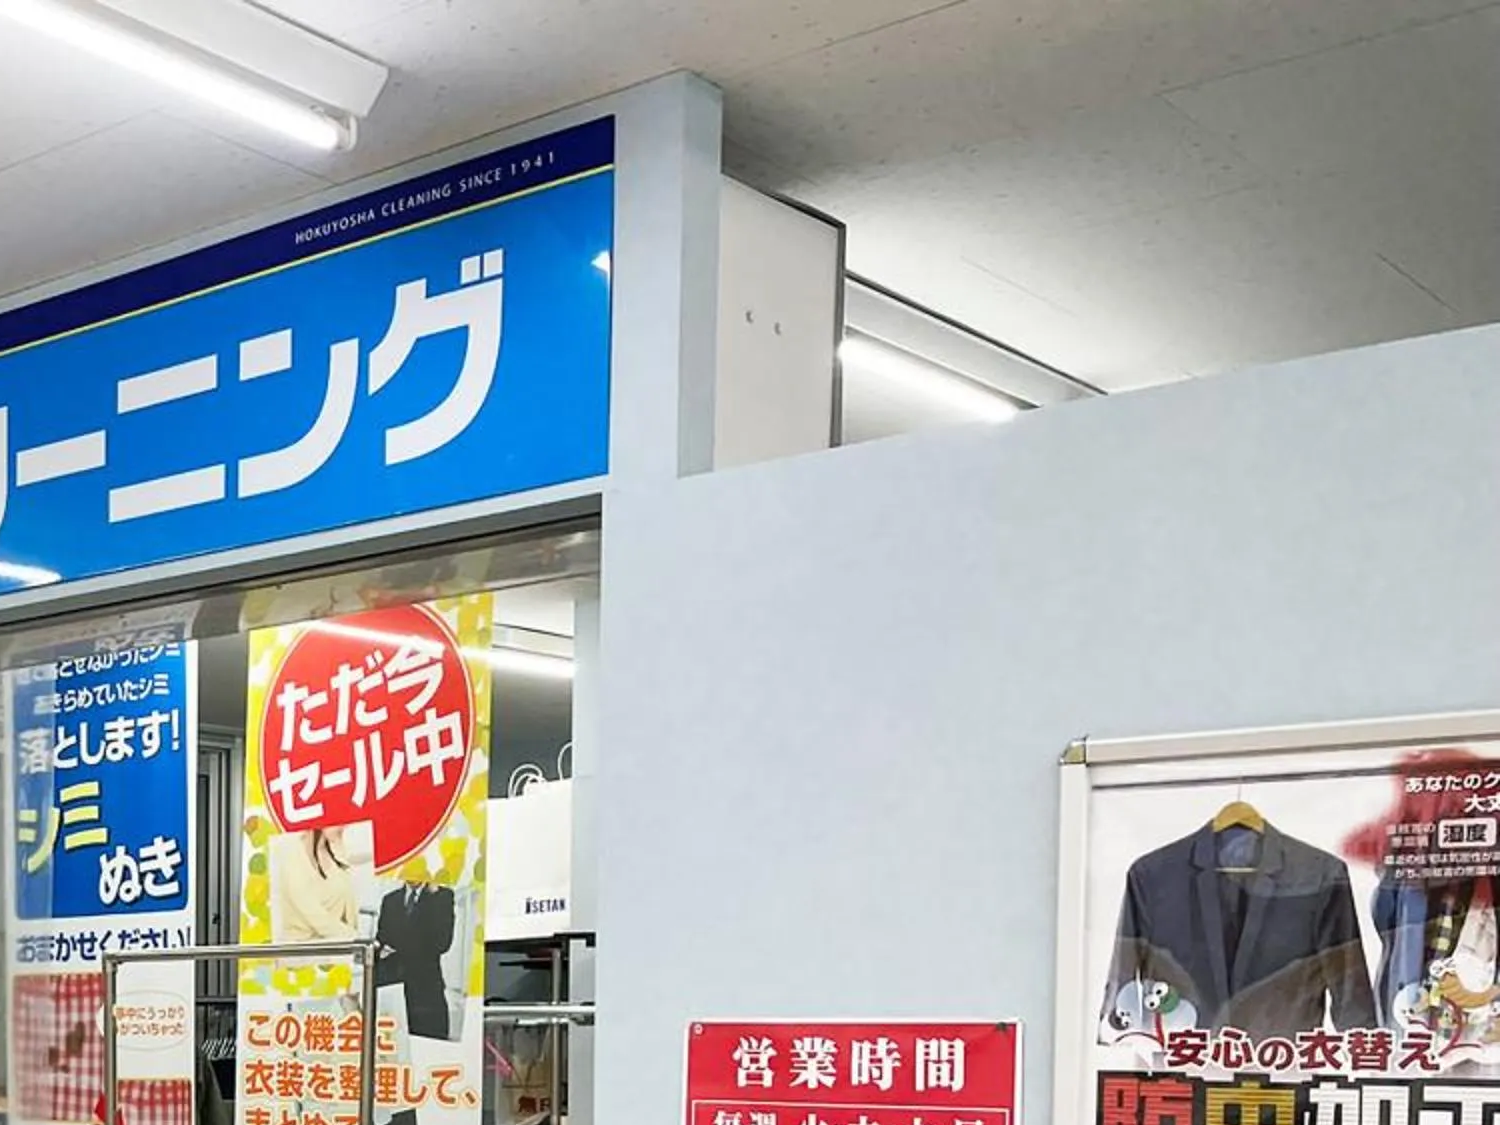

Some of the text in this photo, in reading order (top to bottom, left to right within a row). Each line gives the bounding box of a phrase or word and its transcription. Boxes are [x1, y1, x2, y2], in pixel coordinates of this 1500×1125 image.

[294, 151, 556, 244] HOKUYOSHA CLEANING SINCE 1941
[277, 636, 446, 751] ただ今
[270, 708, 465, 823] セール中
[17, 781, 109, 874] シミ
[98, 836, 183, 906] ぬき
[245, 1014, 396, 1053] この機会に
[733, 1036, 966, 1093] 営業時間
[1166, 1030, 1442, 1073] 安心の衣替え
